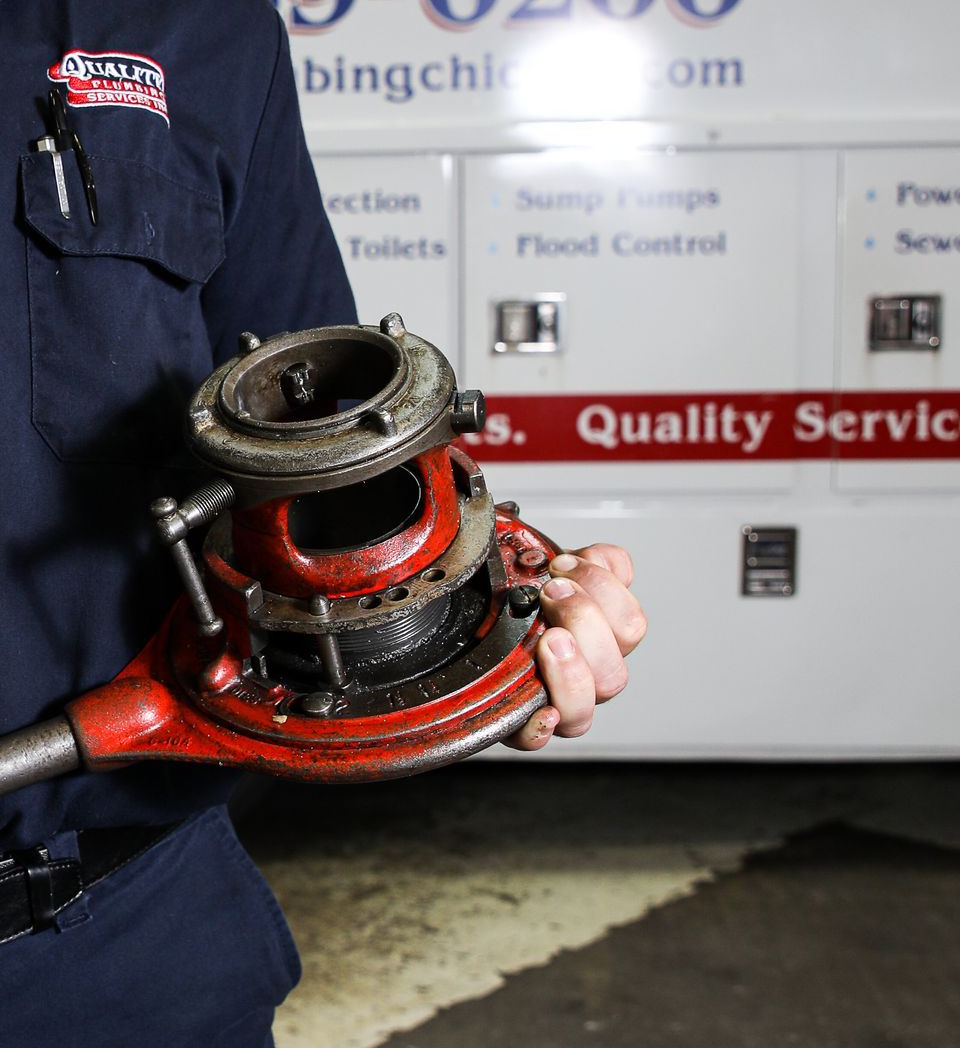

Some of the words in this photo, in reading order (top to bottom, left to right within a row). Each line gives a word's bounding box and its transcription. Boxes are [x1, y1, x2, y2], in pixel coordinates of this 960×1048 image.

[86, 92, 151, 106] SERVICES
[515, 187, 604, 215] Sump
[349, 235, 447, 260] Toilets
[517, 232, 599, 258] Flood
[611, 230, 726, 257] Control
[576, 402, 772, 452] Quality
